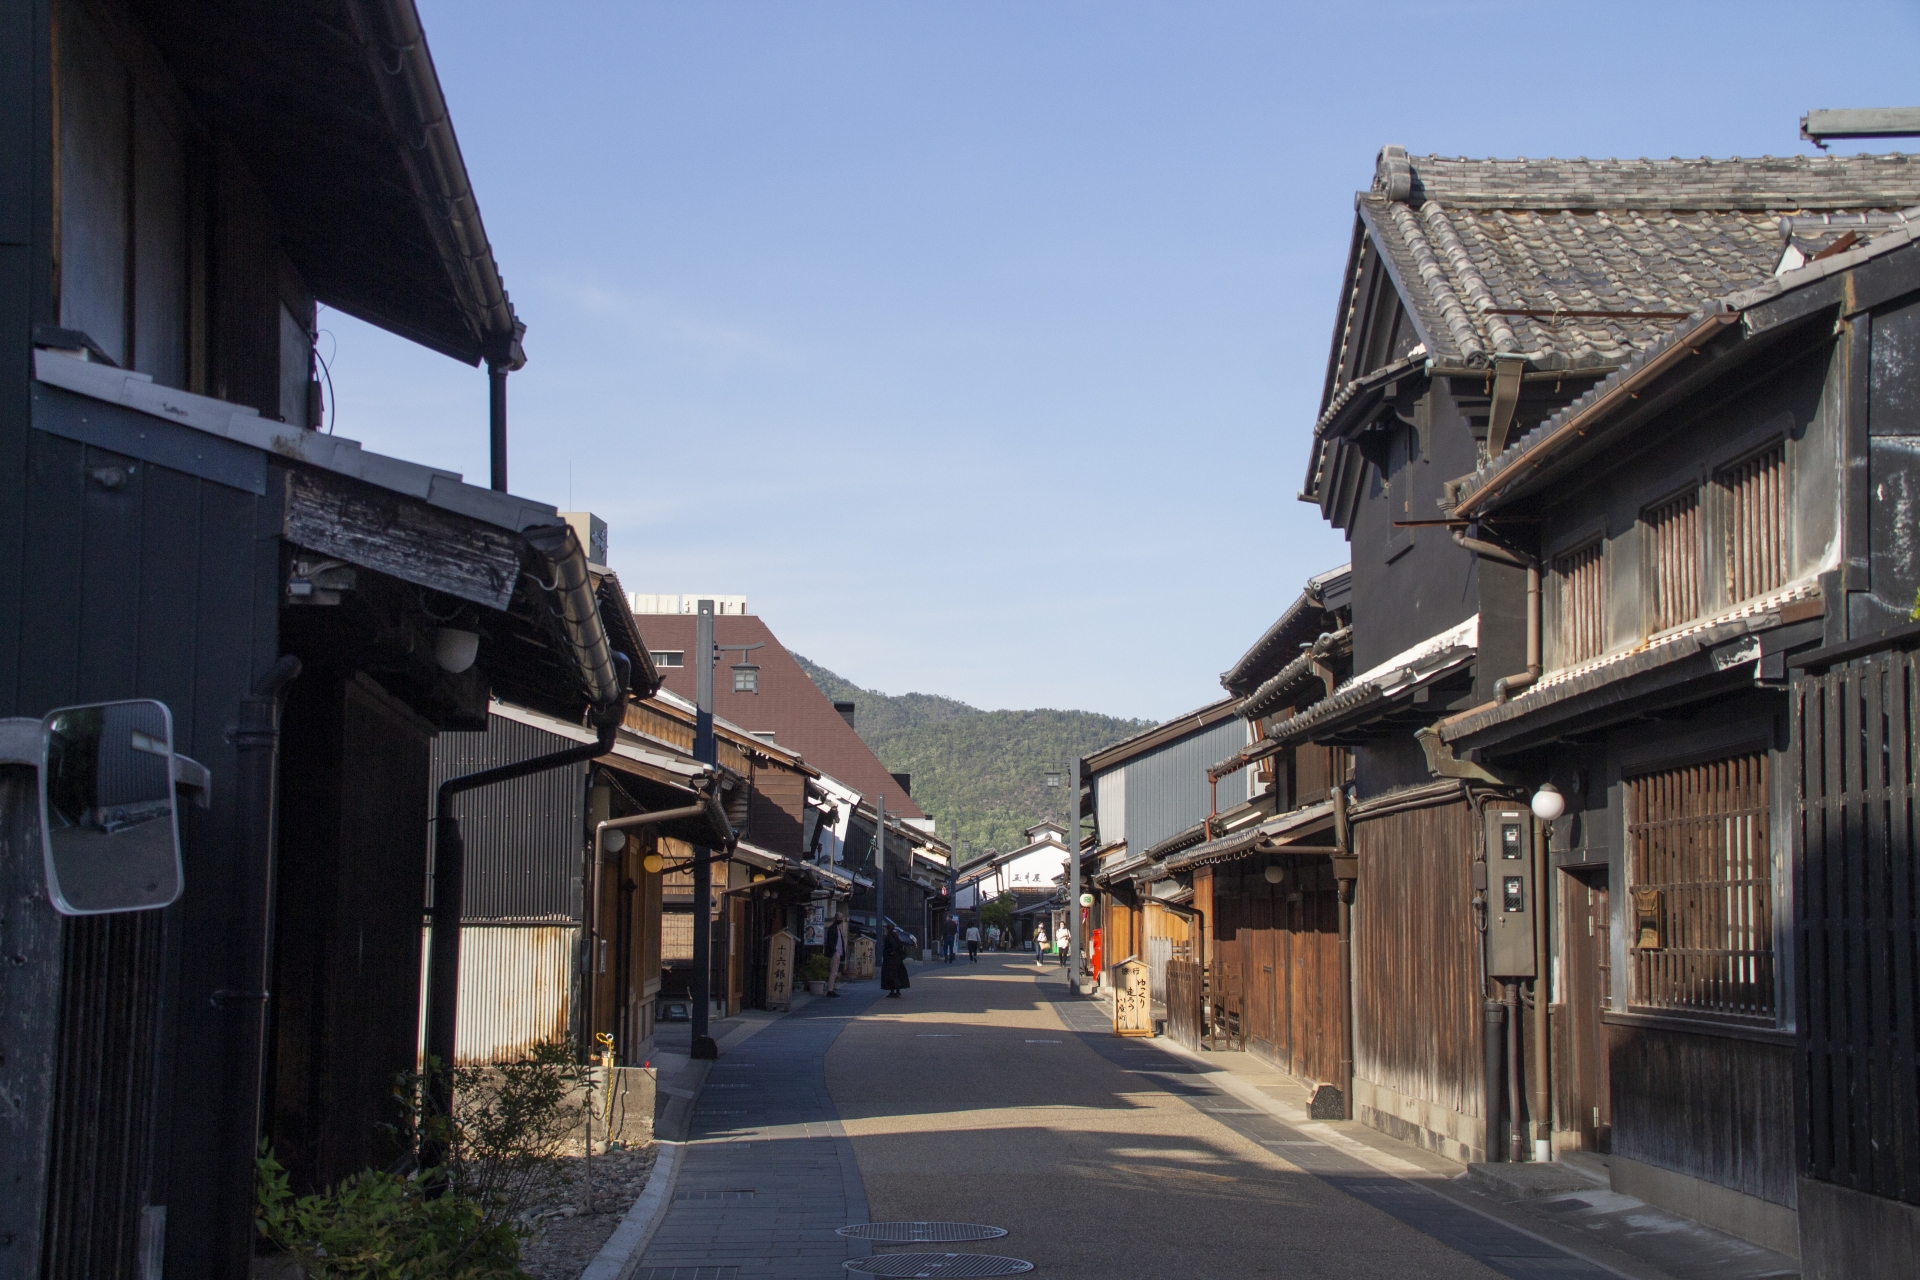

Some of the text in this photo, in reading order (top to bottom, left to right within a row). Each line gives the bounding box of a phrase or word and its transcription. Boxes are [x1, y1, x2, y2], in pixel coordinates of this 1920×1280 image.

[774, 944, 786, 993] 十六銀行
[1122, 967, 1140, 976] 徐行
[1126, 986, 1137, 1012] 走ろう
[1137, 978, 1146, 1009] ゆっくり
